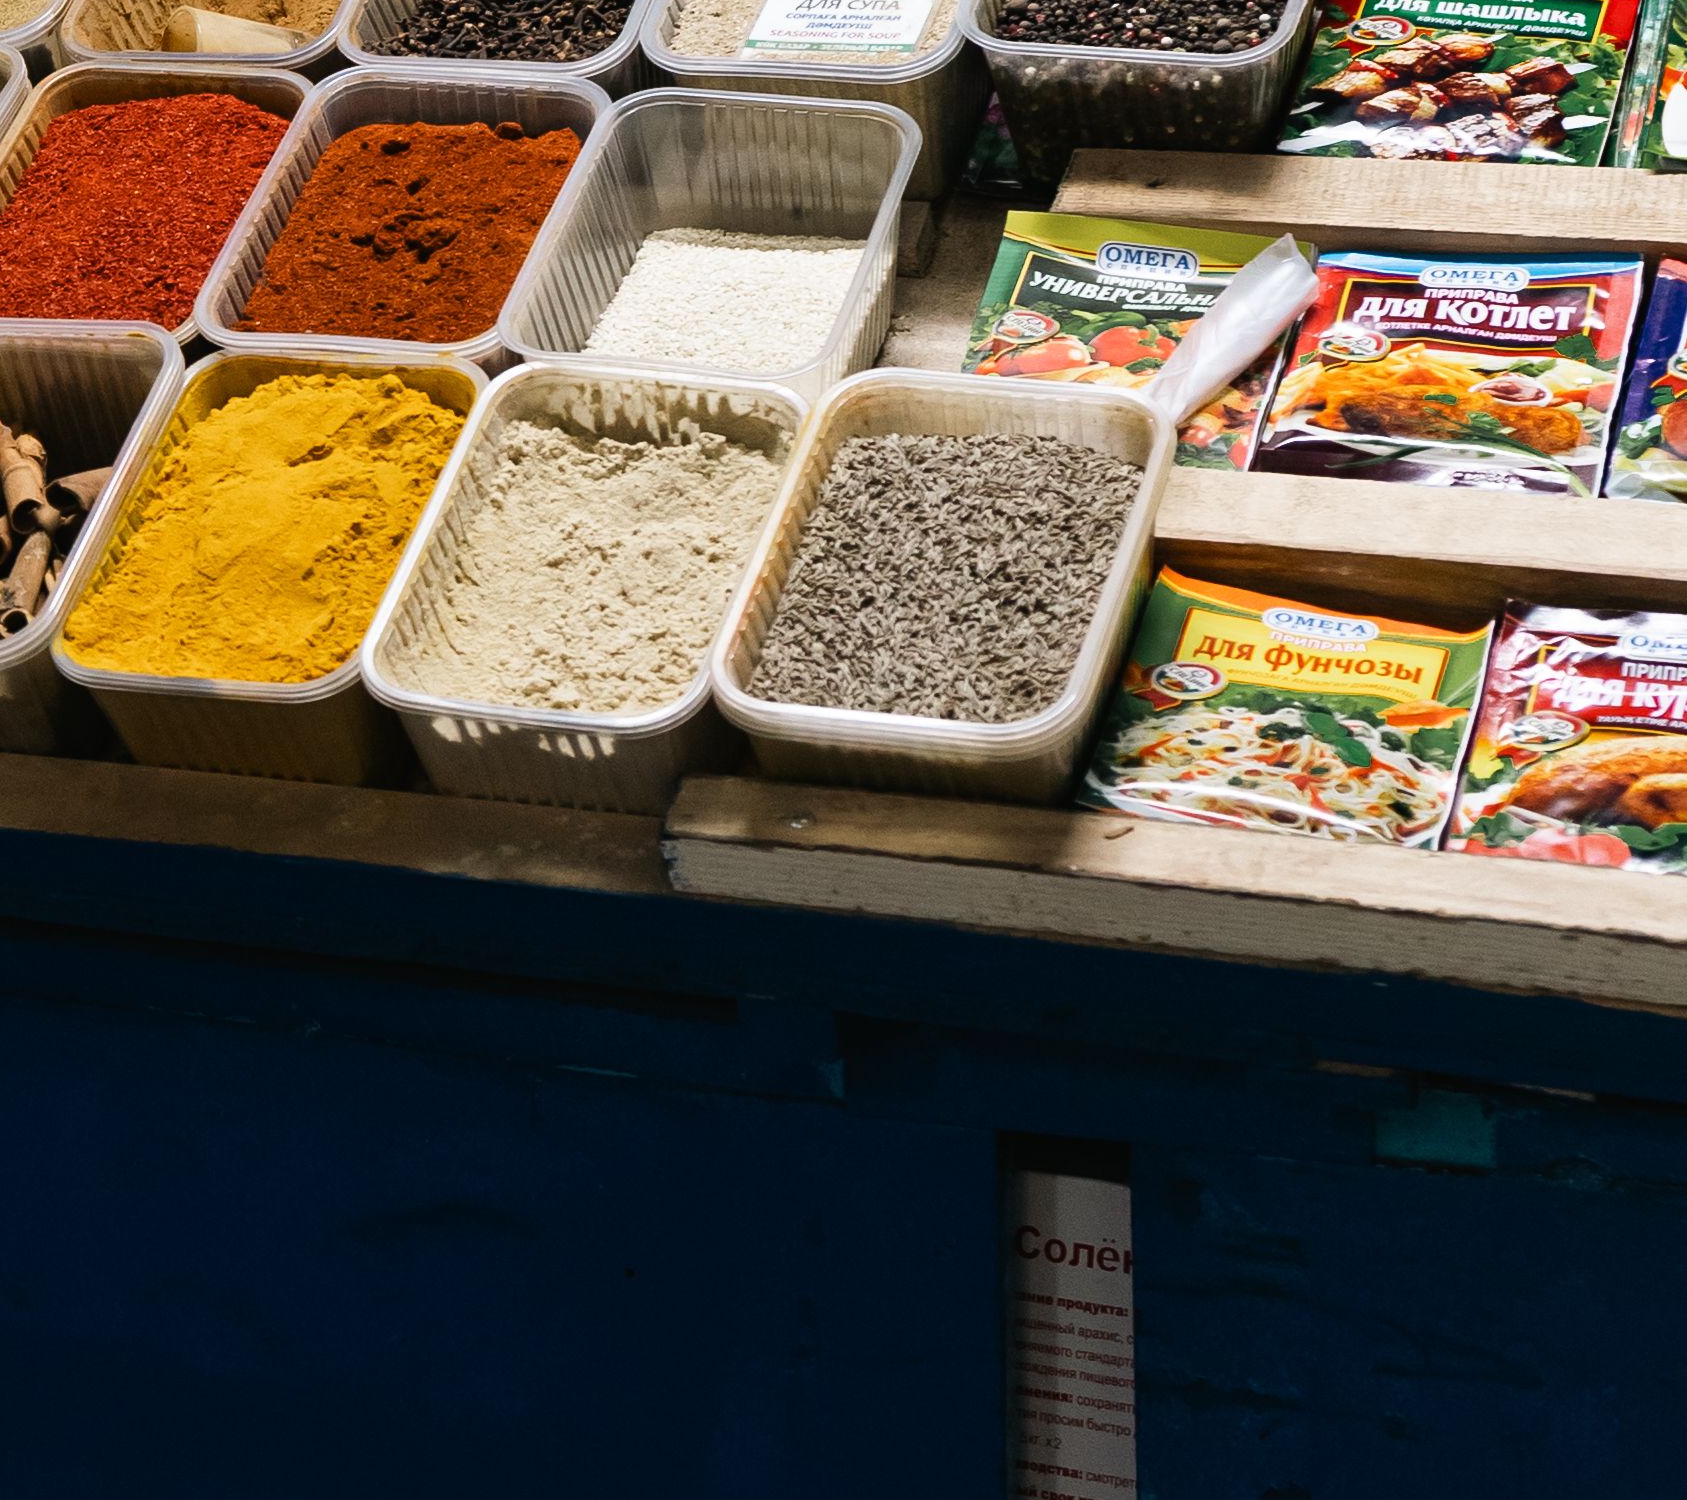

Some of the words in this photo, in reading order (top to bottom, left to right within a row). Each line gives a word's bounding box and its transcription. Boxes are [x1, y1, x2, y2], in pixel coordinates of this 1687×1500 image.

[795, 0, 841, 11] ДЛЯ
[847, 0, 902, 11] СУПА
[1435, 0, 1587, 28] шашлыка
[769, 29, 838, 39] SEASONING
[841, 31, 865, 39] FOR
[867, 32, 902, 40] SOUP
[1105, 246, 1192, 270] ОМЕГА
[1096, 274, 1187, 293] ПРИПРАВА
[1430, 269, 1519, 282] ОМЕГА
[1423, 288, 1519, 305] ПРИПРАВА
[1352, 296, 1428, 324] для
[1274, 611, 1367, 636] ОМЕГА
[1269, 631, 1367, 653] ПРИПРАВА
[1192, 634, 1255, 662] для
[1263, 643, 1424, 685] фунчозы
[1056, 1298, 1129, 1317] продукта:
[1078, 1326, 1125, 1345] арахис,
[1039, 1411, 1084, 1427] просим
[1086, 1417, 1132, 1438] быстро
